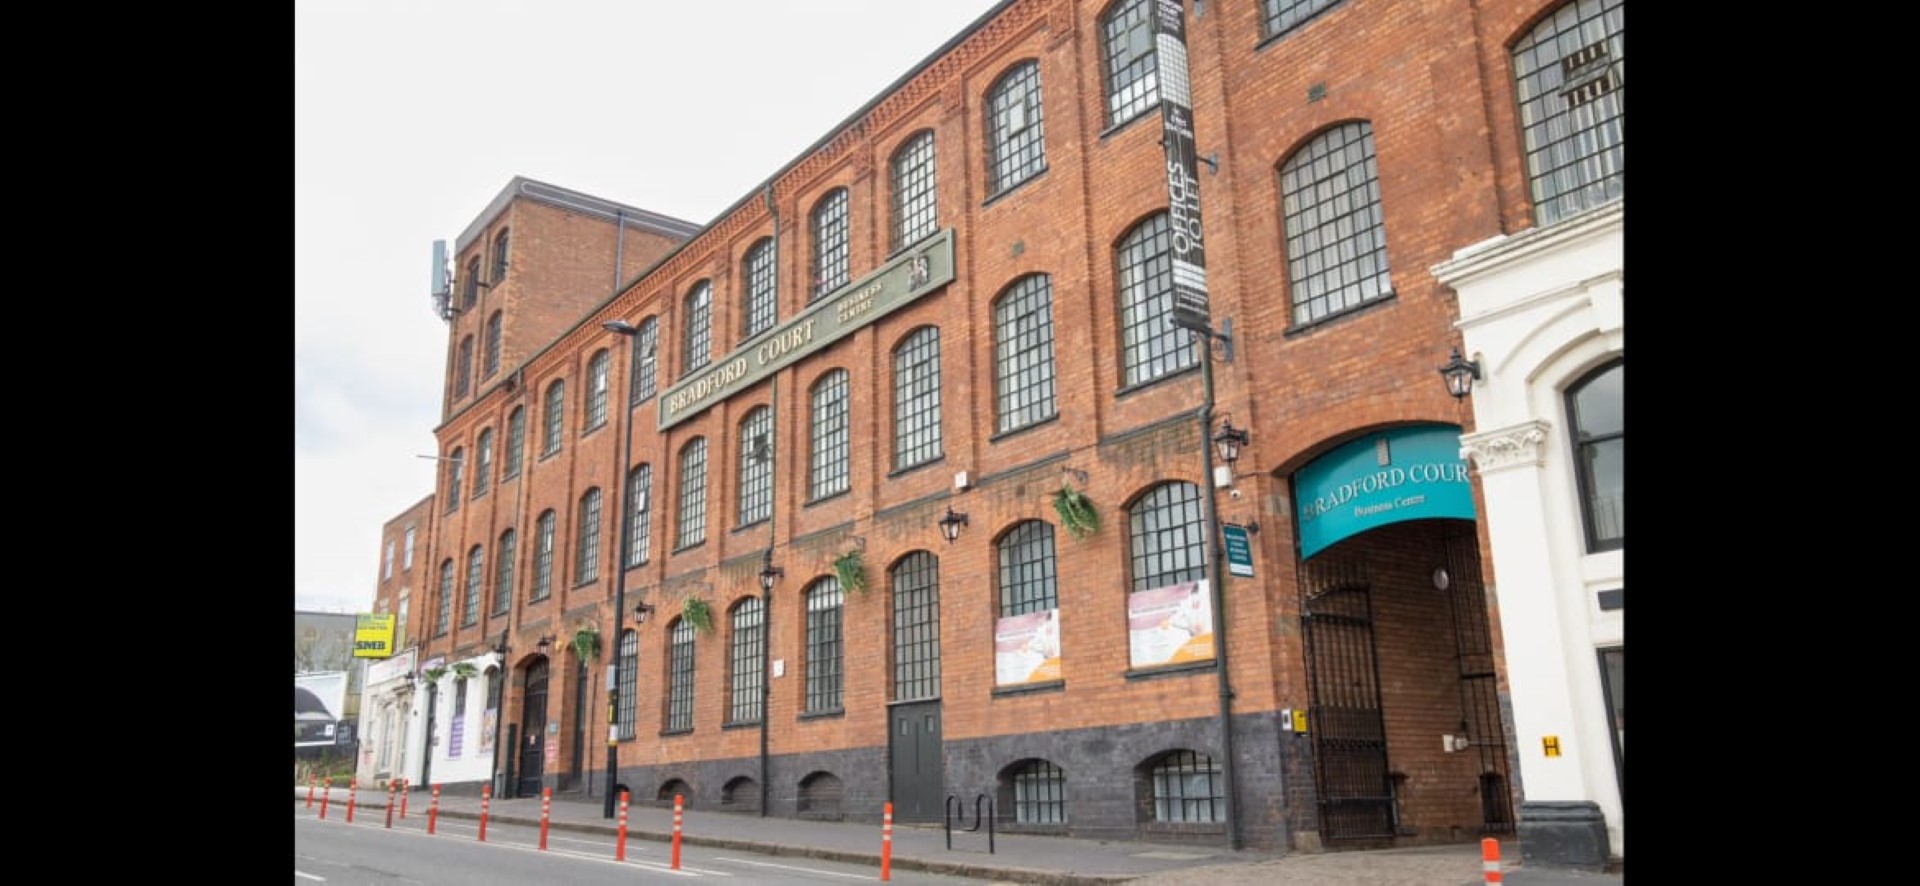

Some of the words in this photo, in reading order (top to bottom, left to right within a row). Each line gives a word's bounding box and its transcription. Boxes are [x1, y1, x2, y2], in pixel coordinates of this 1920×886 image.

[1168, 160, 1189, 254] OFFICES
[1185, 176, 1200, 213] LET
[1188, 218, 1204, 250] TO
[669, 358, 747, 415] BRADFORD
[757, 319, 815, 365] COURT
[1303, 467, 1405, 521] BRADFORD
[1409, 463, 1471, 483] COUR
[1542, 736, 1561, 757] H
